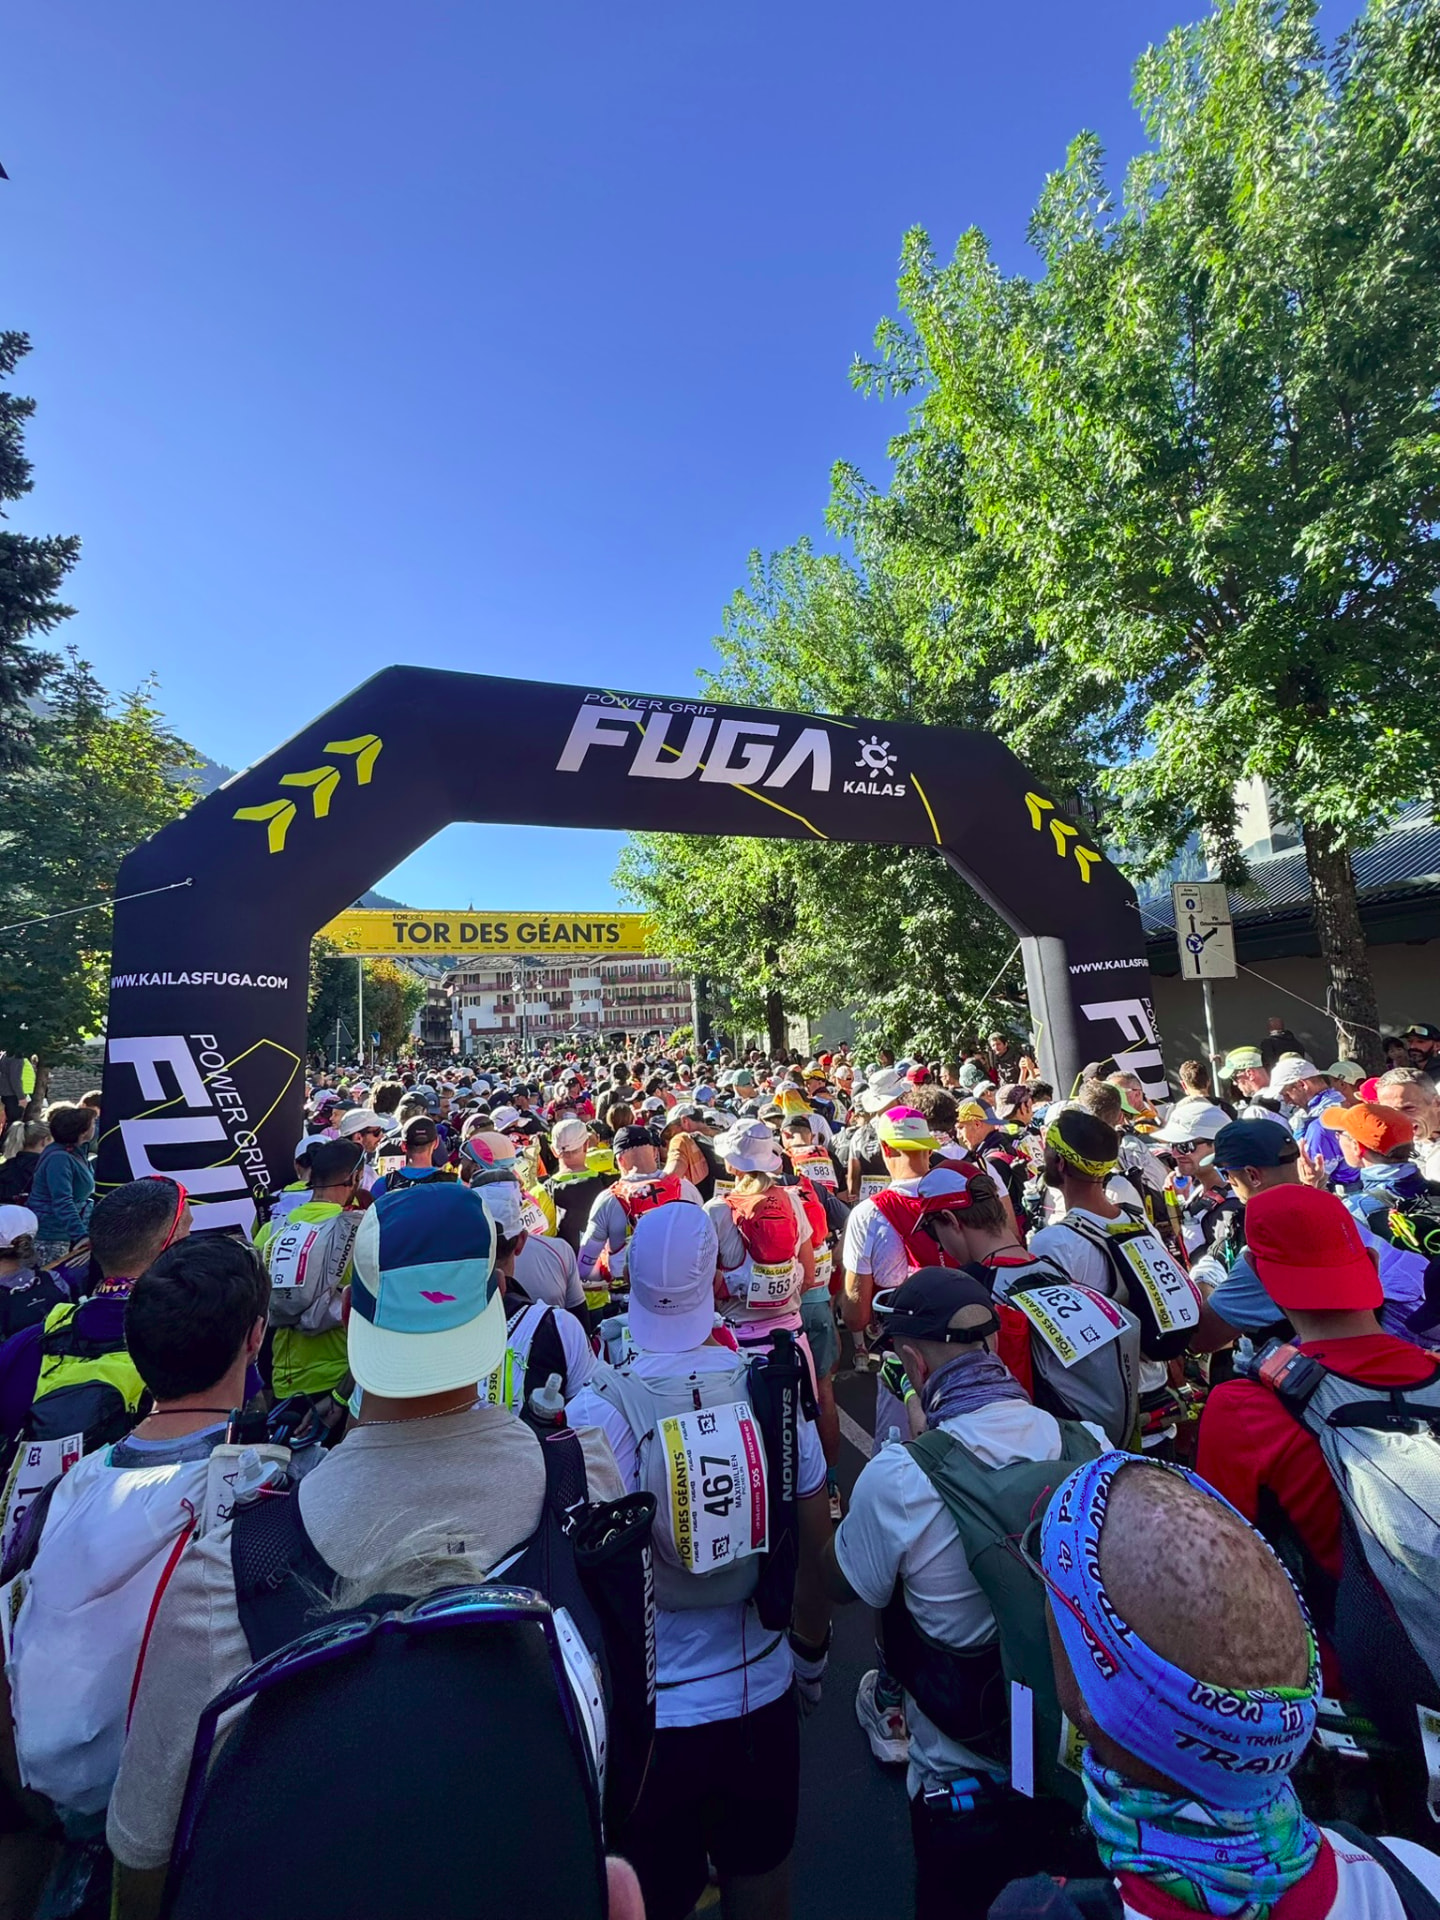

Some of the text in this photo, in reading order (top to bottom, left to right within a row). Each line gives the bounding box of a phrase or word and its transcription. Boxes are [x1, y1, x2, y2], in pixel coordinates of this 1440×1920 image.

[584, 693, 717, 716] POWER GRIP
[555, 704, 831, 792] FUGA
[843, 780, 906, 797] KAILAS
[392, 917, 621, 944] TOR DES GÉANTS
[112, 972, 288, 990] WWW.KAILASFUGA.COM
[190, 1034, 272, 1189] POWER GRIP
[276, 1237, 297, 1264] 176
[336, 1224, 358, 1278] SALOMON
[768, 1279, 790, 1295] 553
[1152, 1260, 1181, 1296] 133
[1038, 1288, 1083, 1319] 230
[1152, 1291, 1164, 1307] DES
[1041, 1318, 1057, 1335] DES
[1159, 1308, 1170, 1325] TOR
[1055, 1336, 1073, 1357] TOR
[489, 1373, 498, 1390] DES
[782, 1387, 793, 1502] SALOMON
[700, 1455, 734, 1517] 467
[733, 1454, 742, 1508] MAXIMILIEN
[752, 1468, 761, 1489] SOS
[674, 1452, 691, 1560] TOR DES GÉANTS
[641, 1544, 656, 1705] SALOMON
